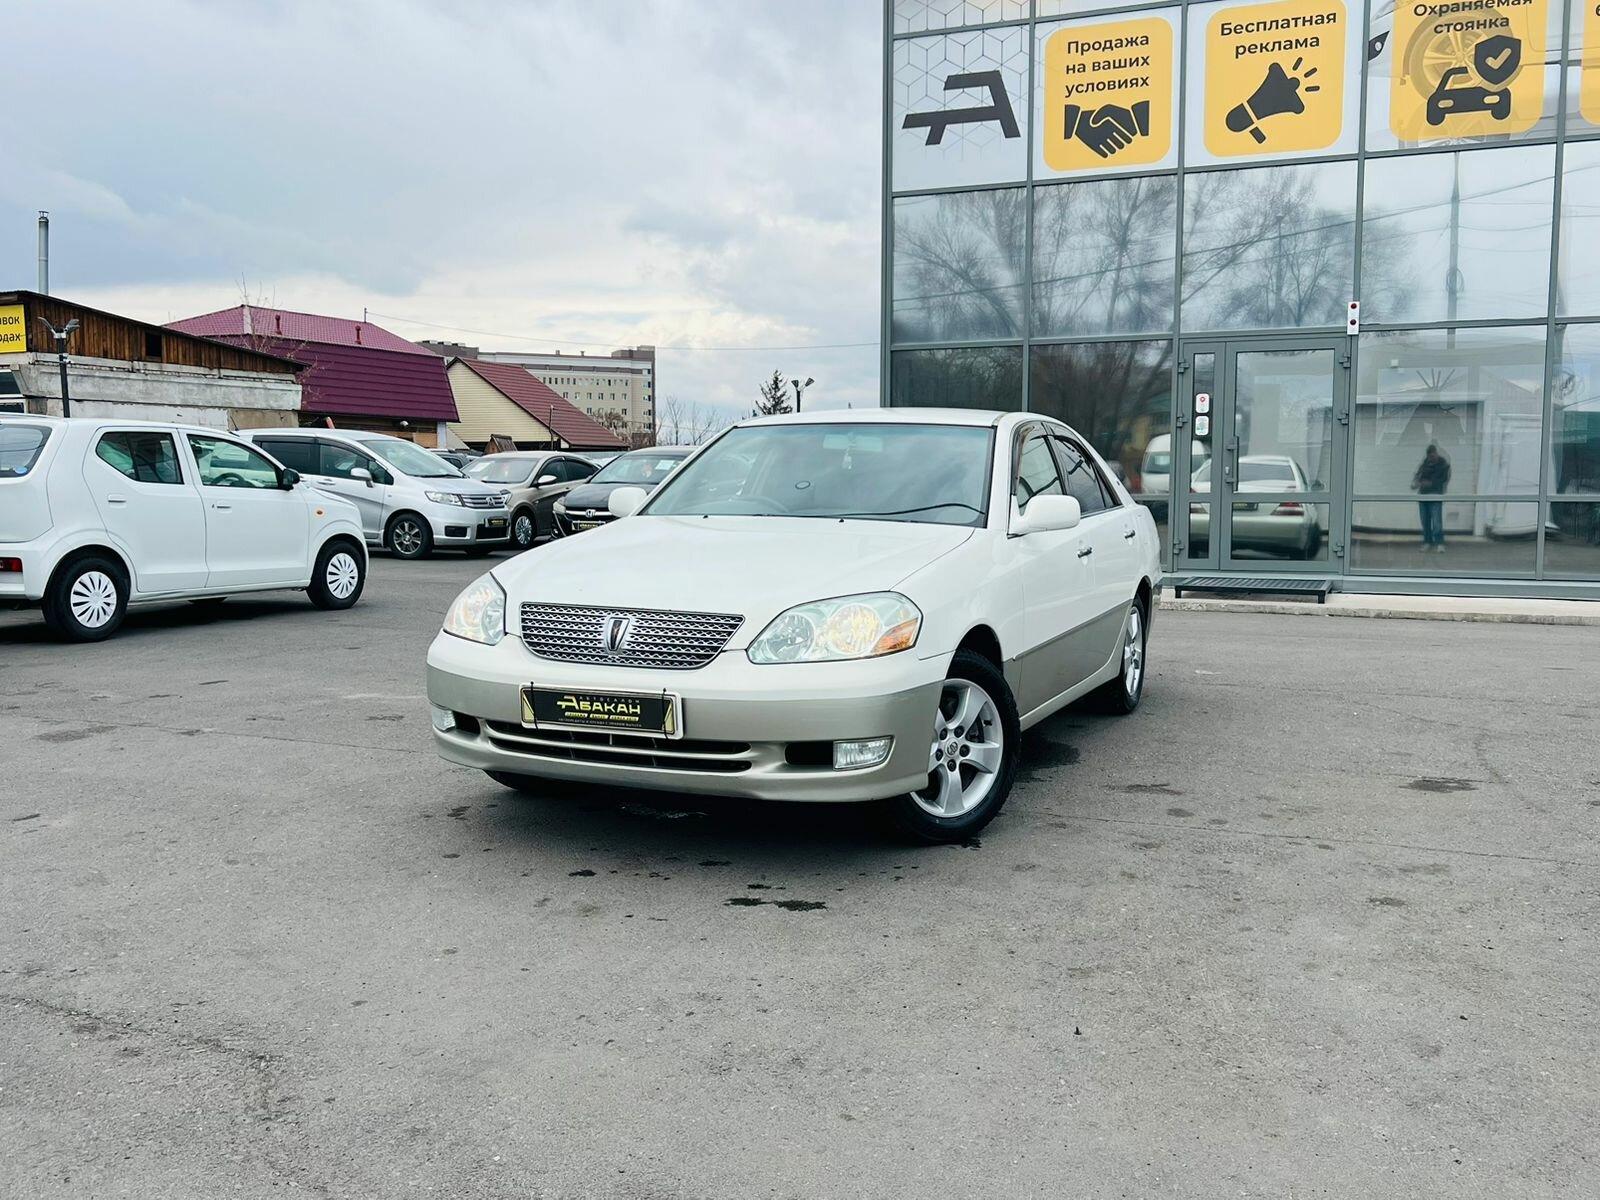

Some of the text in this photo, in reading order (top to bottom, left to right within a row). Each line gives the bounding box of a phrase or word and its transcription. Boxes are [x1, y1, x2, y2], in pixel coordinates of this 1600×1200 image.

[1220, 12, 1337, 36] Бесплатная
[1433, 17, 1509, 34] стоянка
[1067, 35, 1149, 56] Продажа
[1235, 36, 1320, 59] реклама
[1066, 56, 1150, 75] на ваших
[1064, 76, 1149, 98] условиях
[0, 316, 20, 325] вок
[557, 695, 641, 715] АБАКАН
